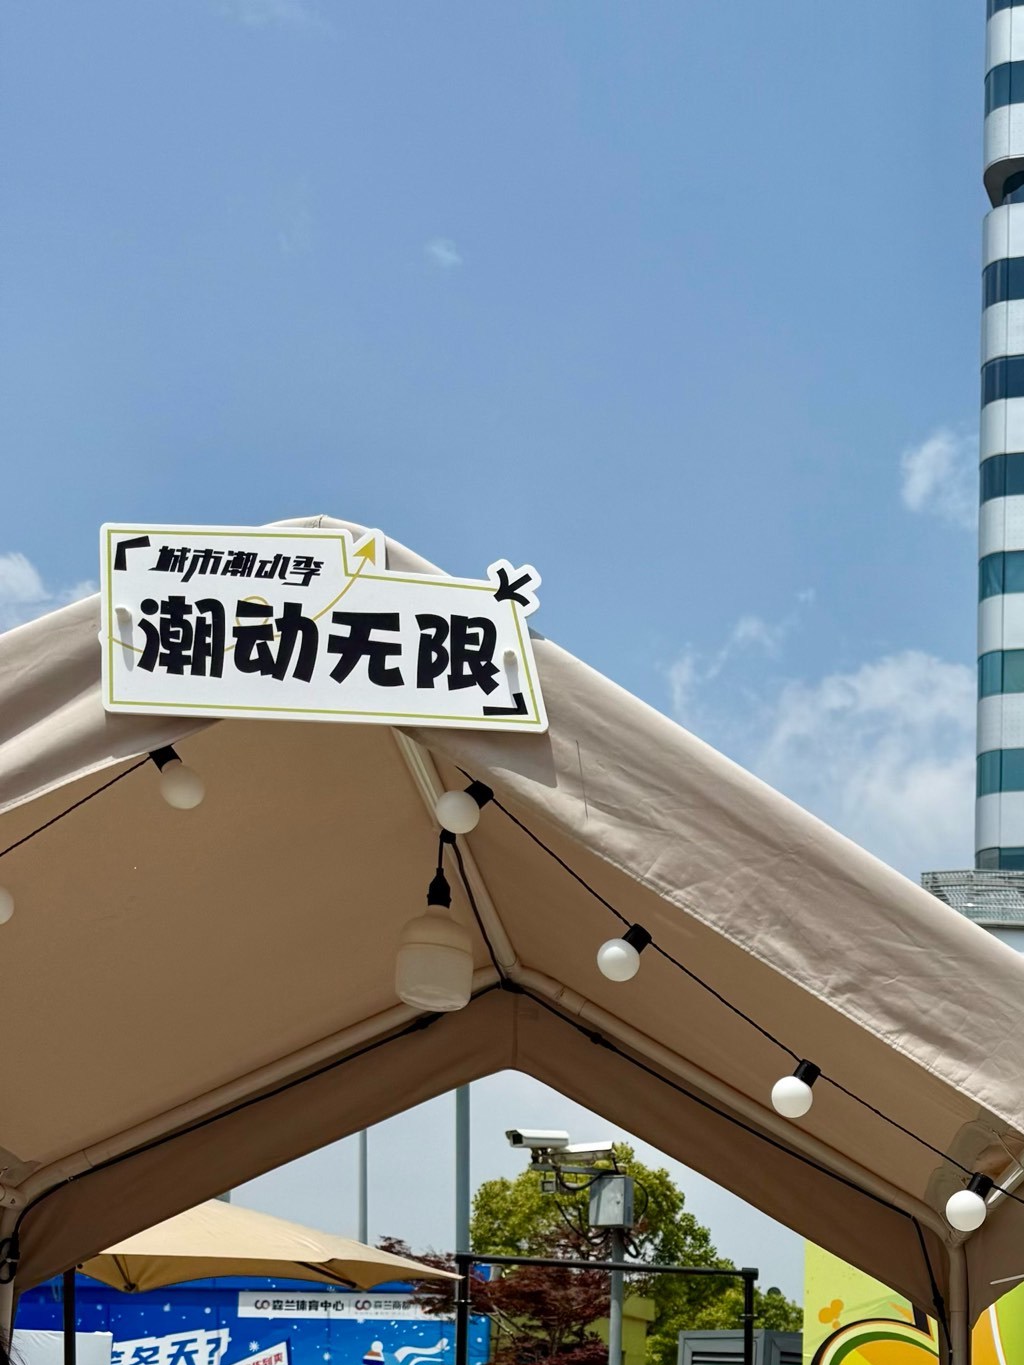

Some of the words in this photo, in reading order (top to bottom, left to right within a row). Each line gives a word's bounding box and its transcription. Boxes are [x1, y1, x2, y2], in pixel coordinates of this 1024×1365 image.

[149, 545, 324, 586] 城市潮动季
[137, 596, 501, 695] 潮动无限
[272, 1299, 345, 1312] 森兰体育中心
